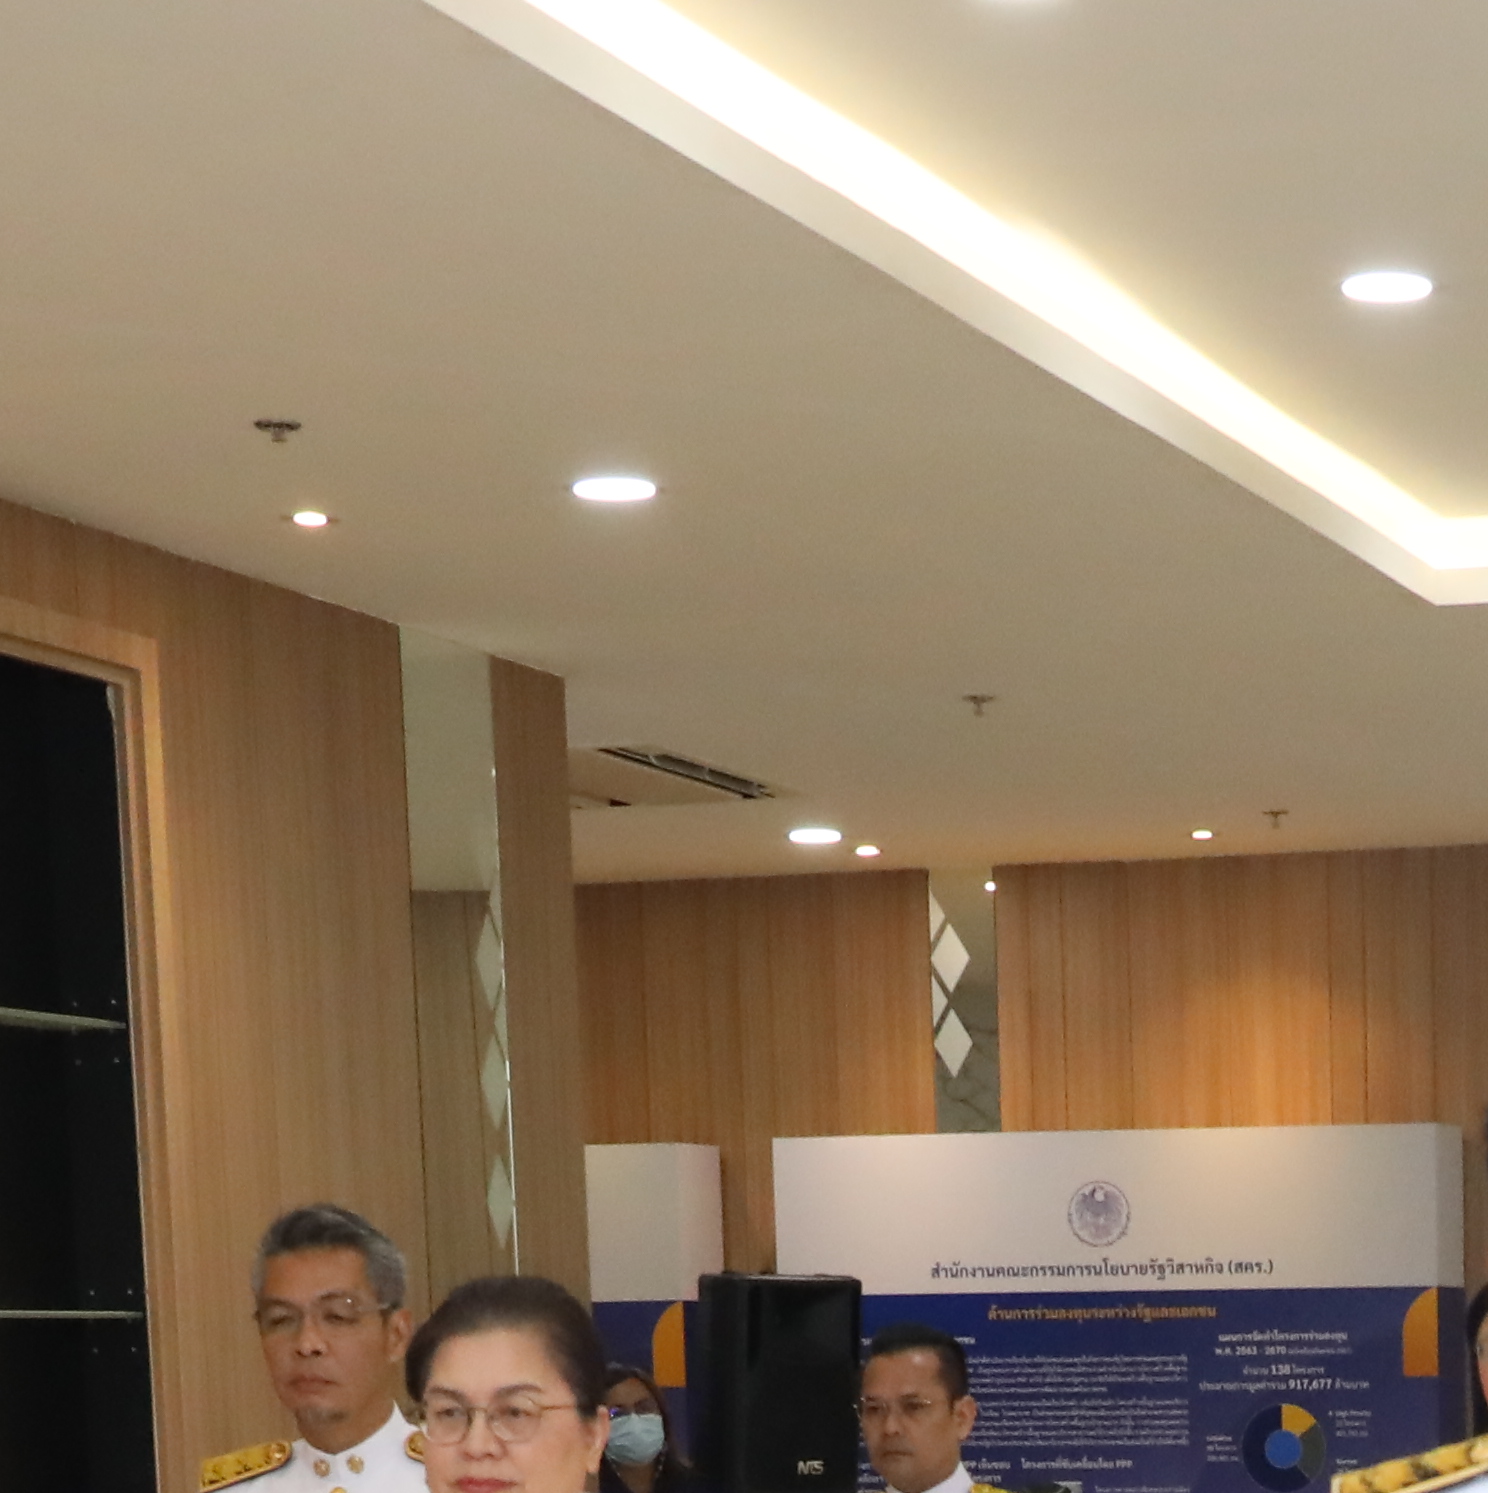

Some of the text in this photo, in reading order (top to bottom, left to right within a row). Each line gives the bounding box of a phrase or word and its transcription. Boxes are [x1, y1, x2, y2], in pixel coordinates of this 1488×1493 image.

[931, 1257, 1275, 1281] สำนักงานคณะกรรมการนโยบายรัฐวิสาหกิจ (สคร.)
[1288, 1379, 1333, 1391] 917,677
